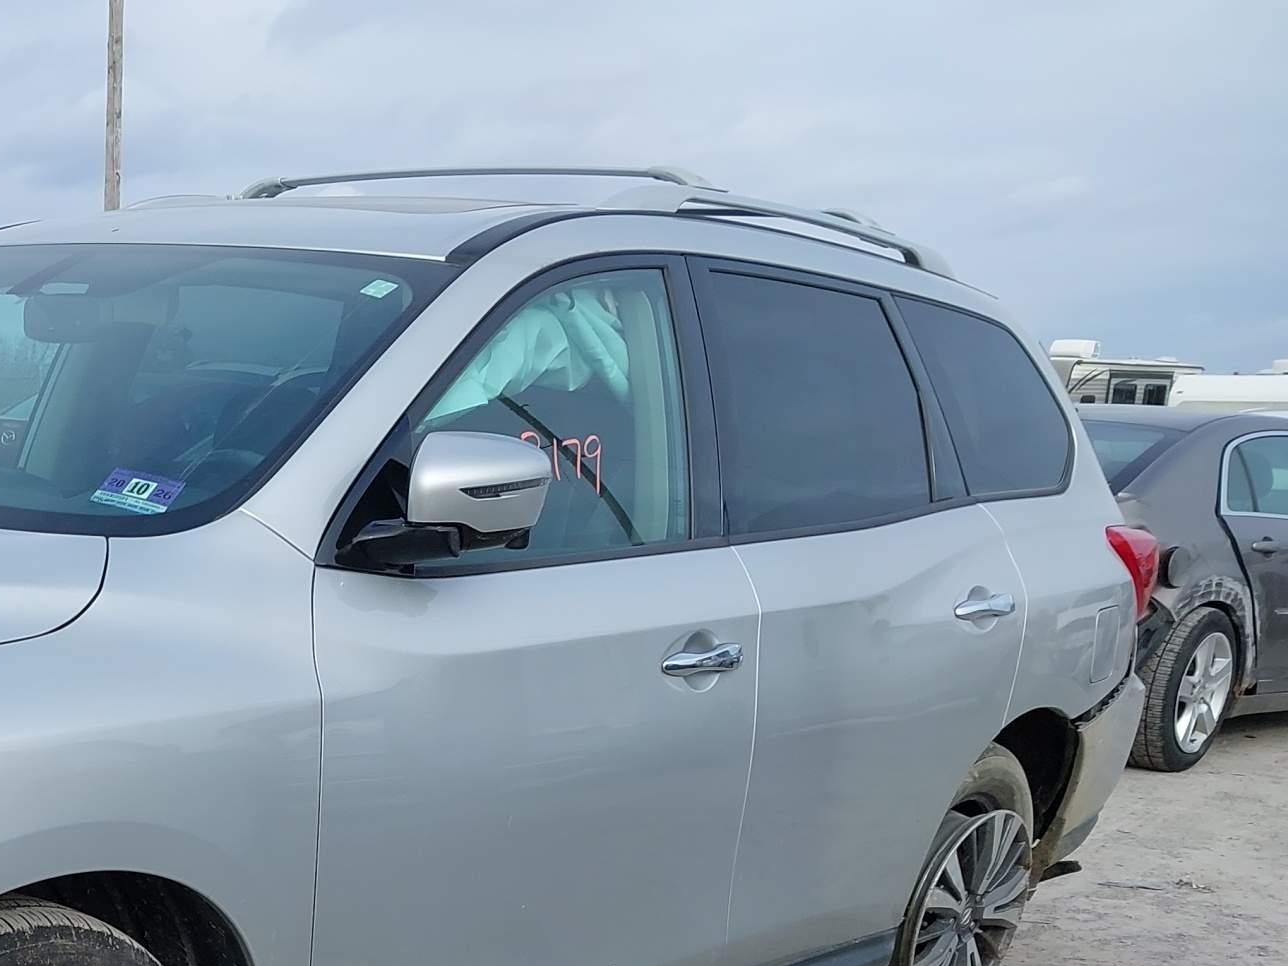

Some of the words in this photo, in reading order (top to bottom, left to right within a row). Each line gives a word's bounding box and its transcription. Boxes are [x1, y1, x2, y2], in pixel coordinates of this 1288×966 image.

[108, 478, 126, 488] 20
[127, 481, 151, 496] 10
[153, 489, 172, 500] 26
